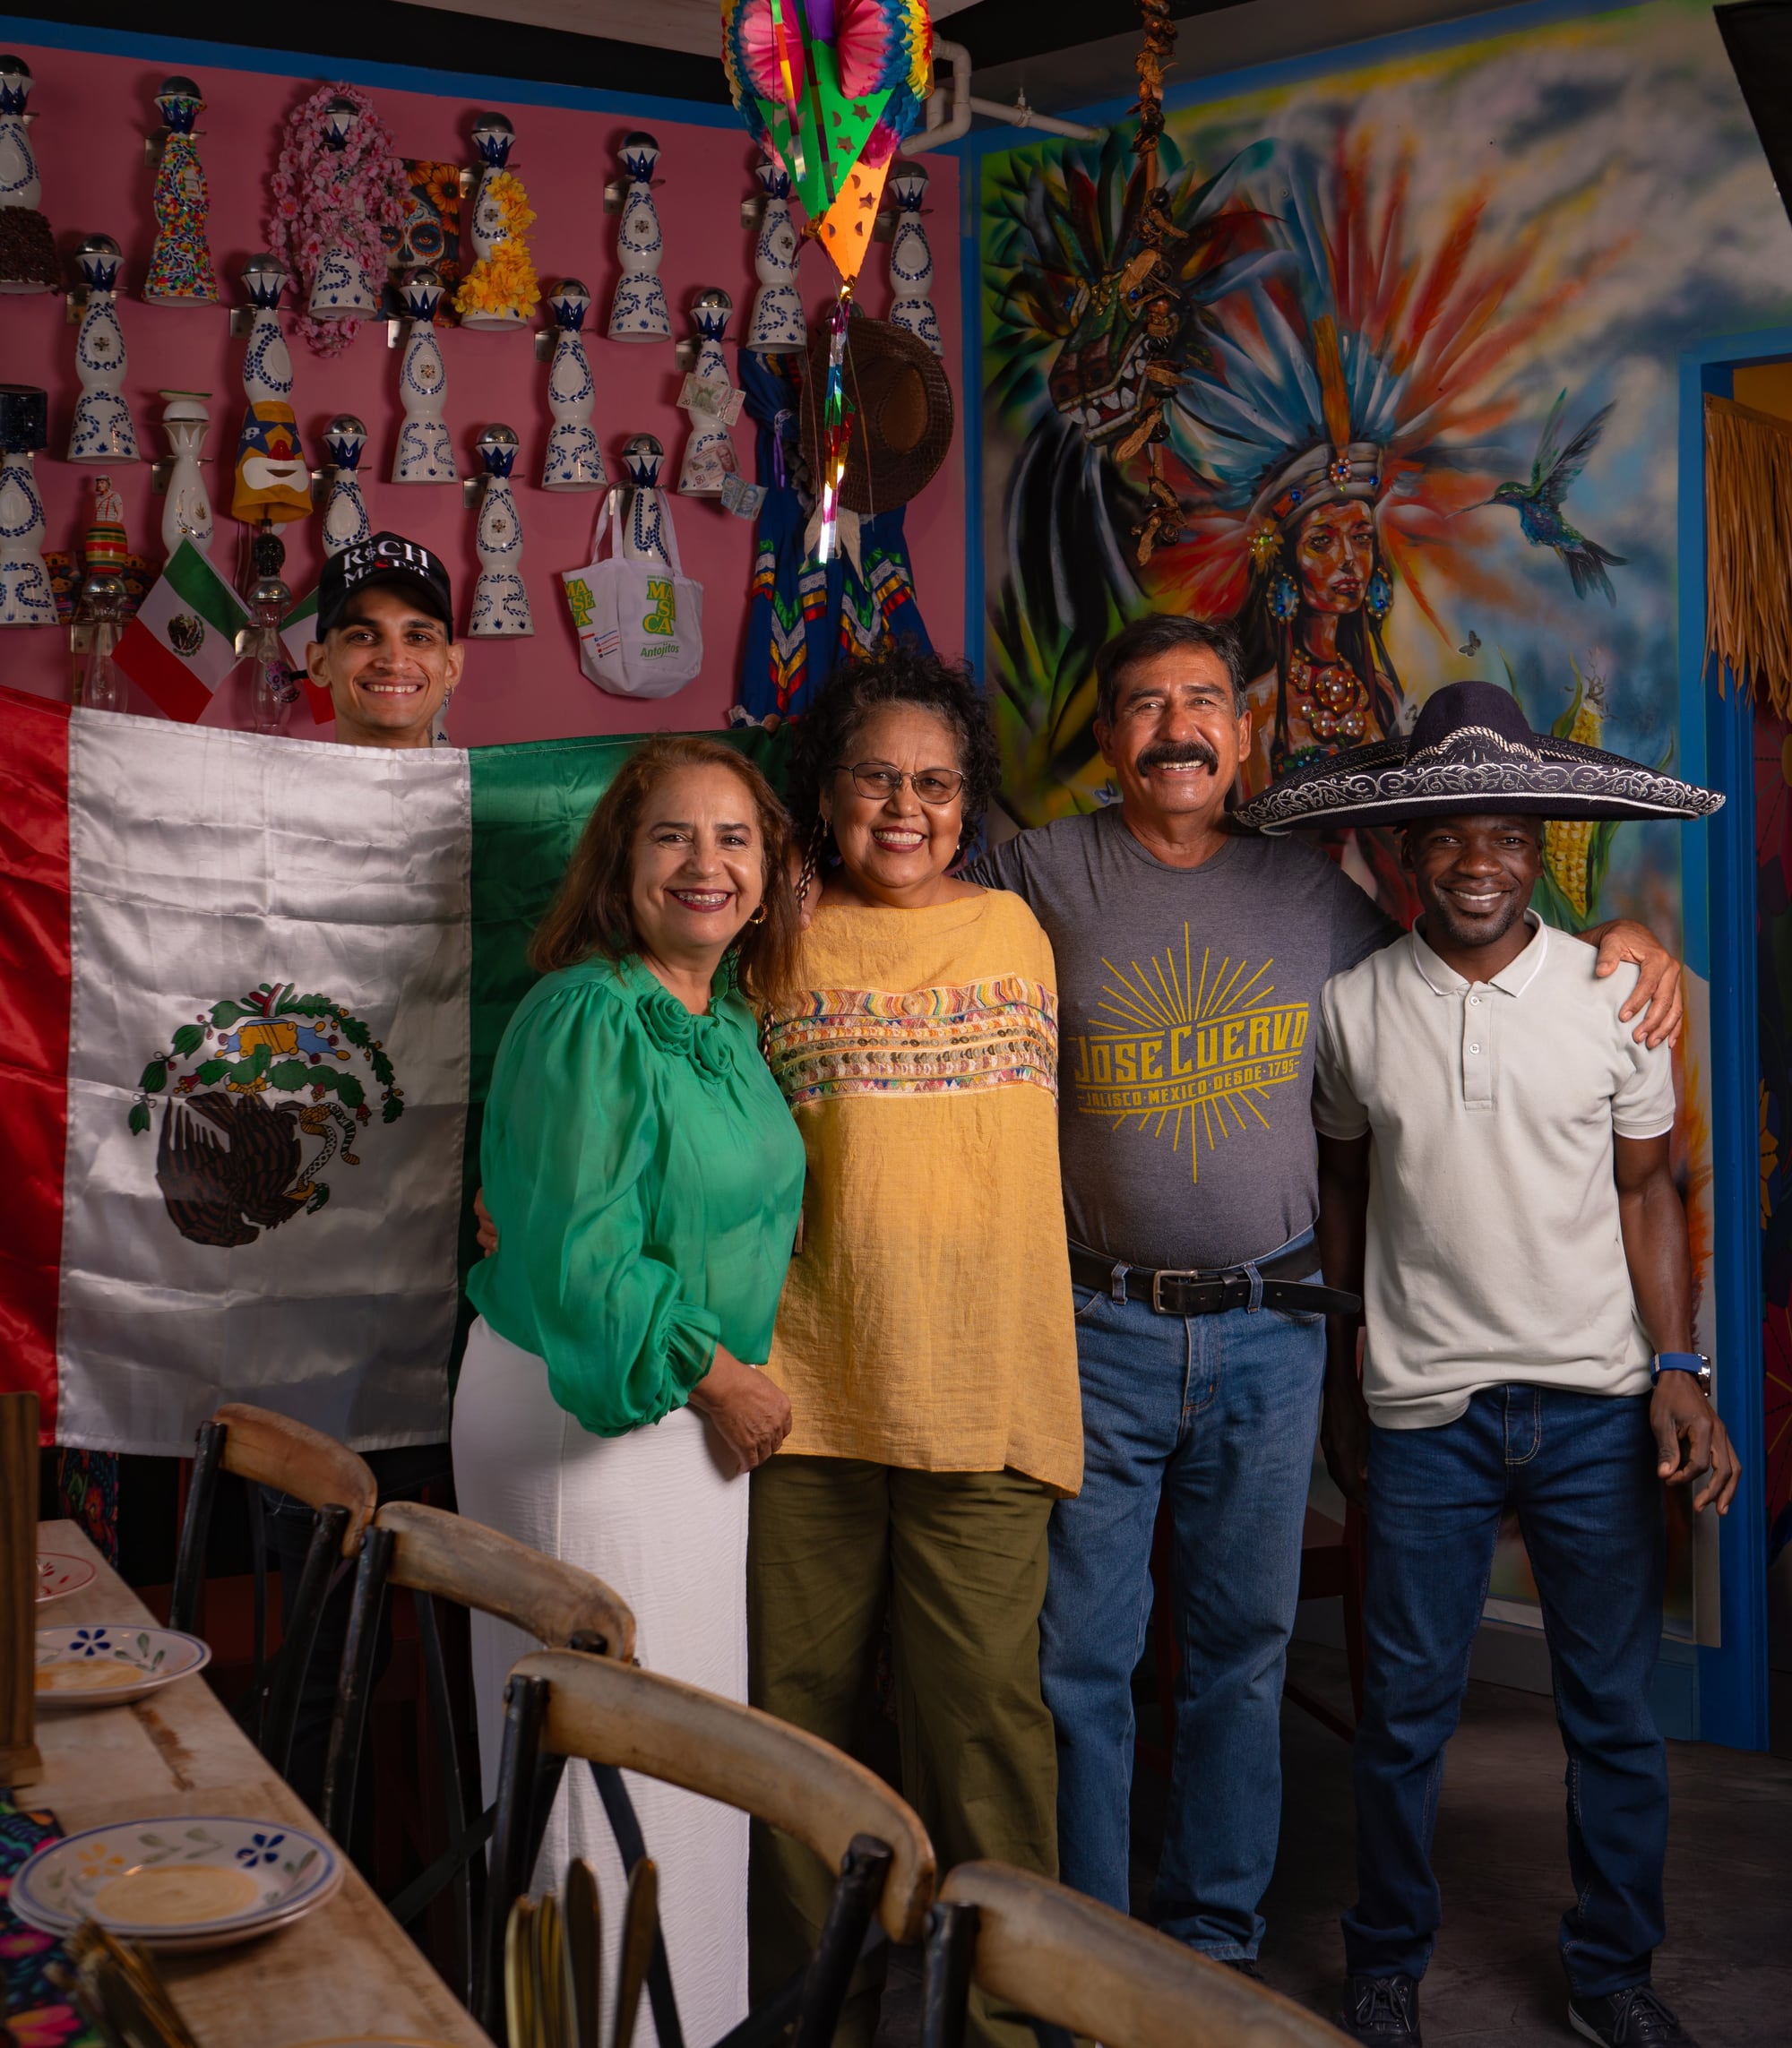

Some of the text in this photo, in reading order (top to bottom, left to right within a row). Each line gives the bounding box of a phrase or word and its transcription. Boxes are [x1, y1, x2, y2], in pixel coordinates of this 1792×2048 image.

[642, 613, 674, 636] CA
[641, 642, 680, 658] Antojitos
[1074, 1011, 1309, 1083] JOSE CUERVO
[1086, 1058, 1295, 1107] JALISCO MEXICO DESDE 1795
